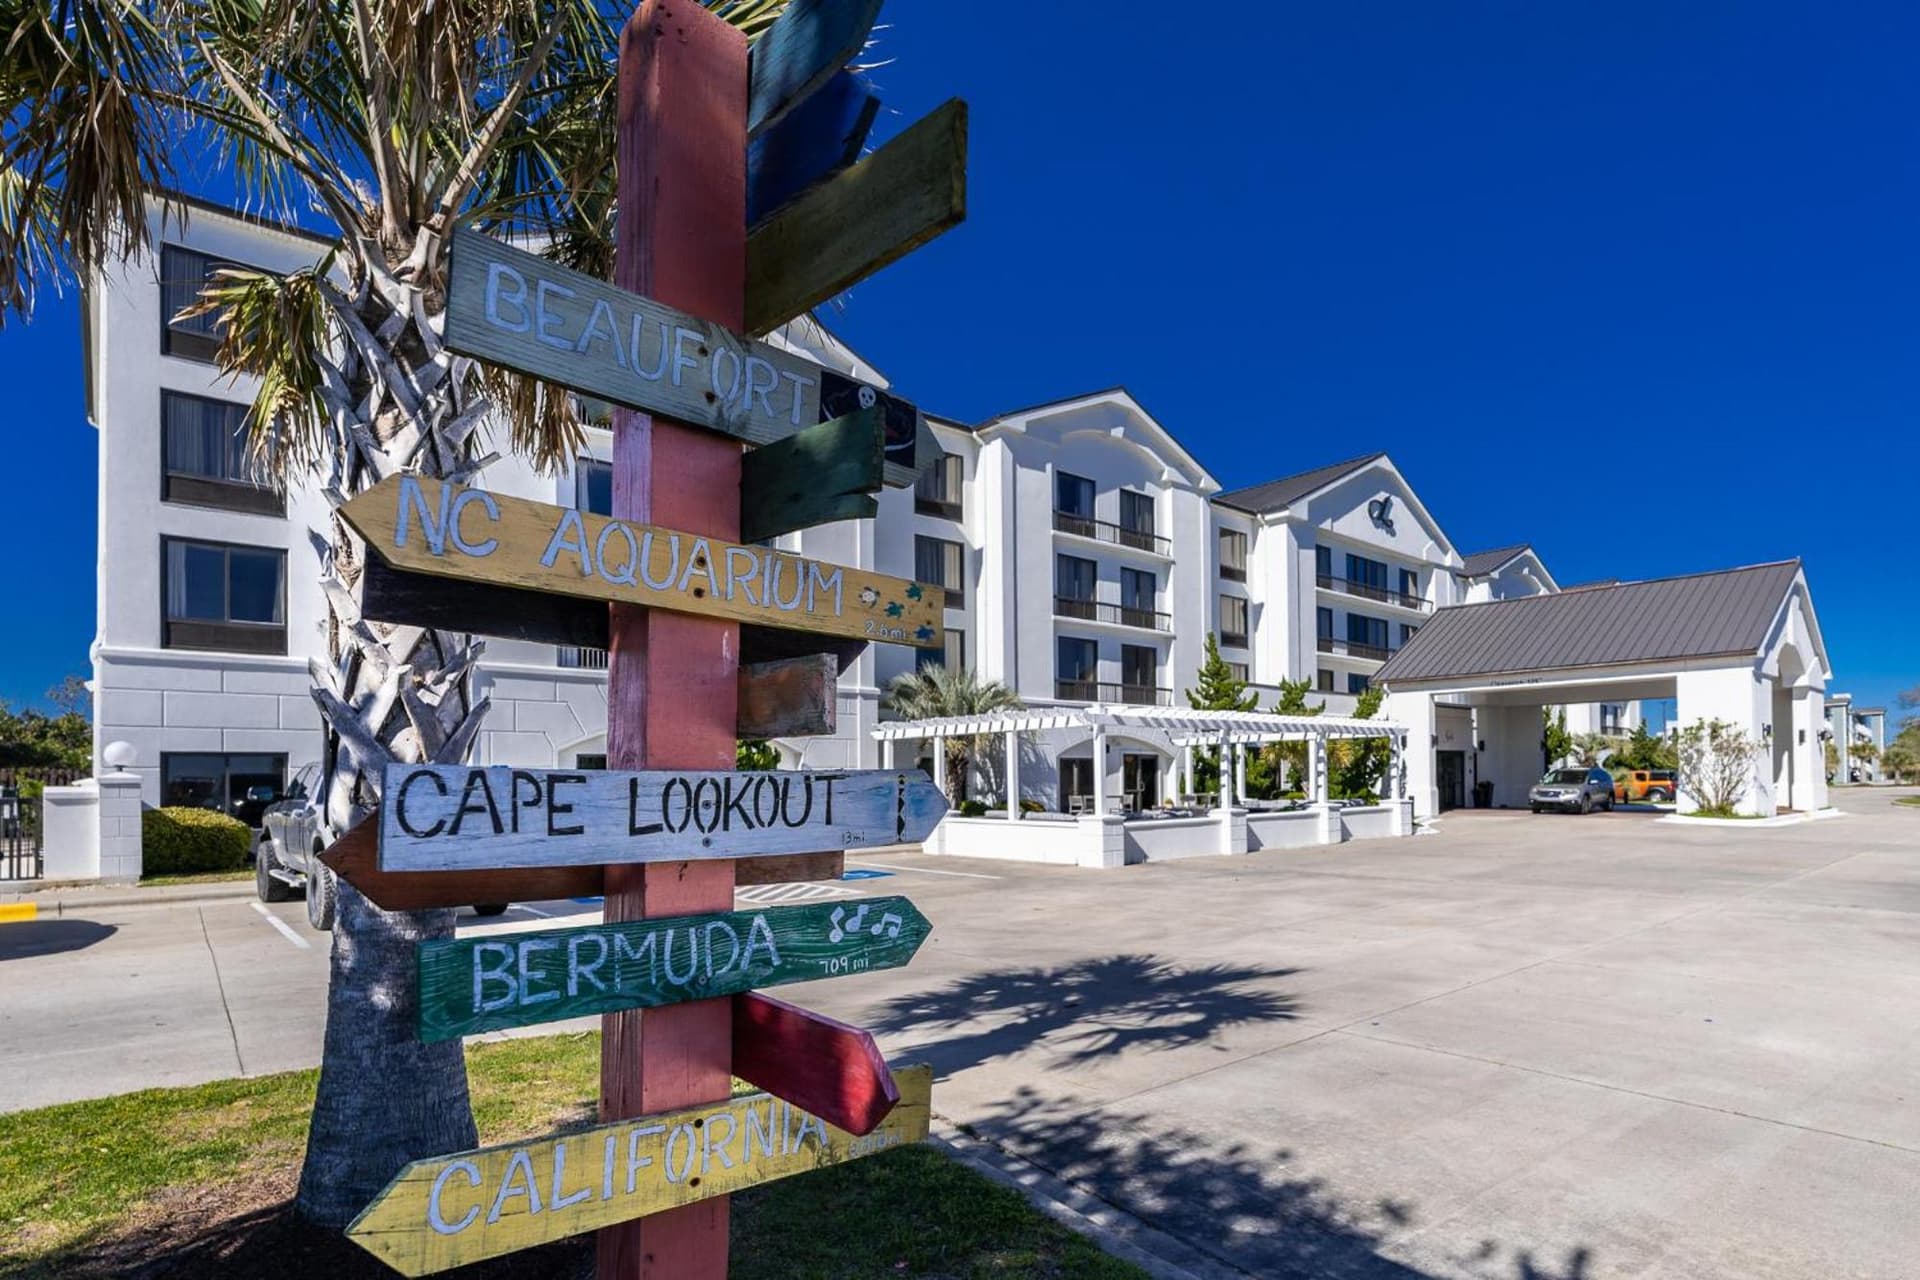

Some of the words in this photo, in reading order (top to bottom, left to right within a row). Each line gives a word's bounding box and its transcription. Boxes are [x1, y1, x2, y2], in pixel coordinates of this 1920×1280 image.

[484, 262, 816, 425] BEAUFORT
[394, 478, 500, 557] NC
[539, 510, 843, 617] AQUARIUM
[396, 769, 587, 838] CAPE
[629, 774, 846, 837] LOOKOUT
[472, 913, 783, 1013] BERMUDA
[819, 956, 848, 974] 709
[427, 1101, 829, 1236] CALIFORNIA
